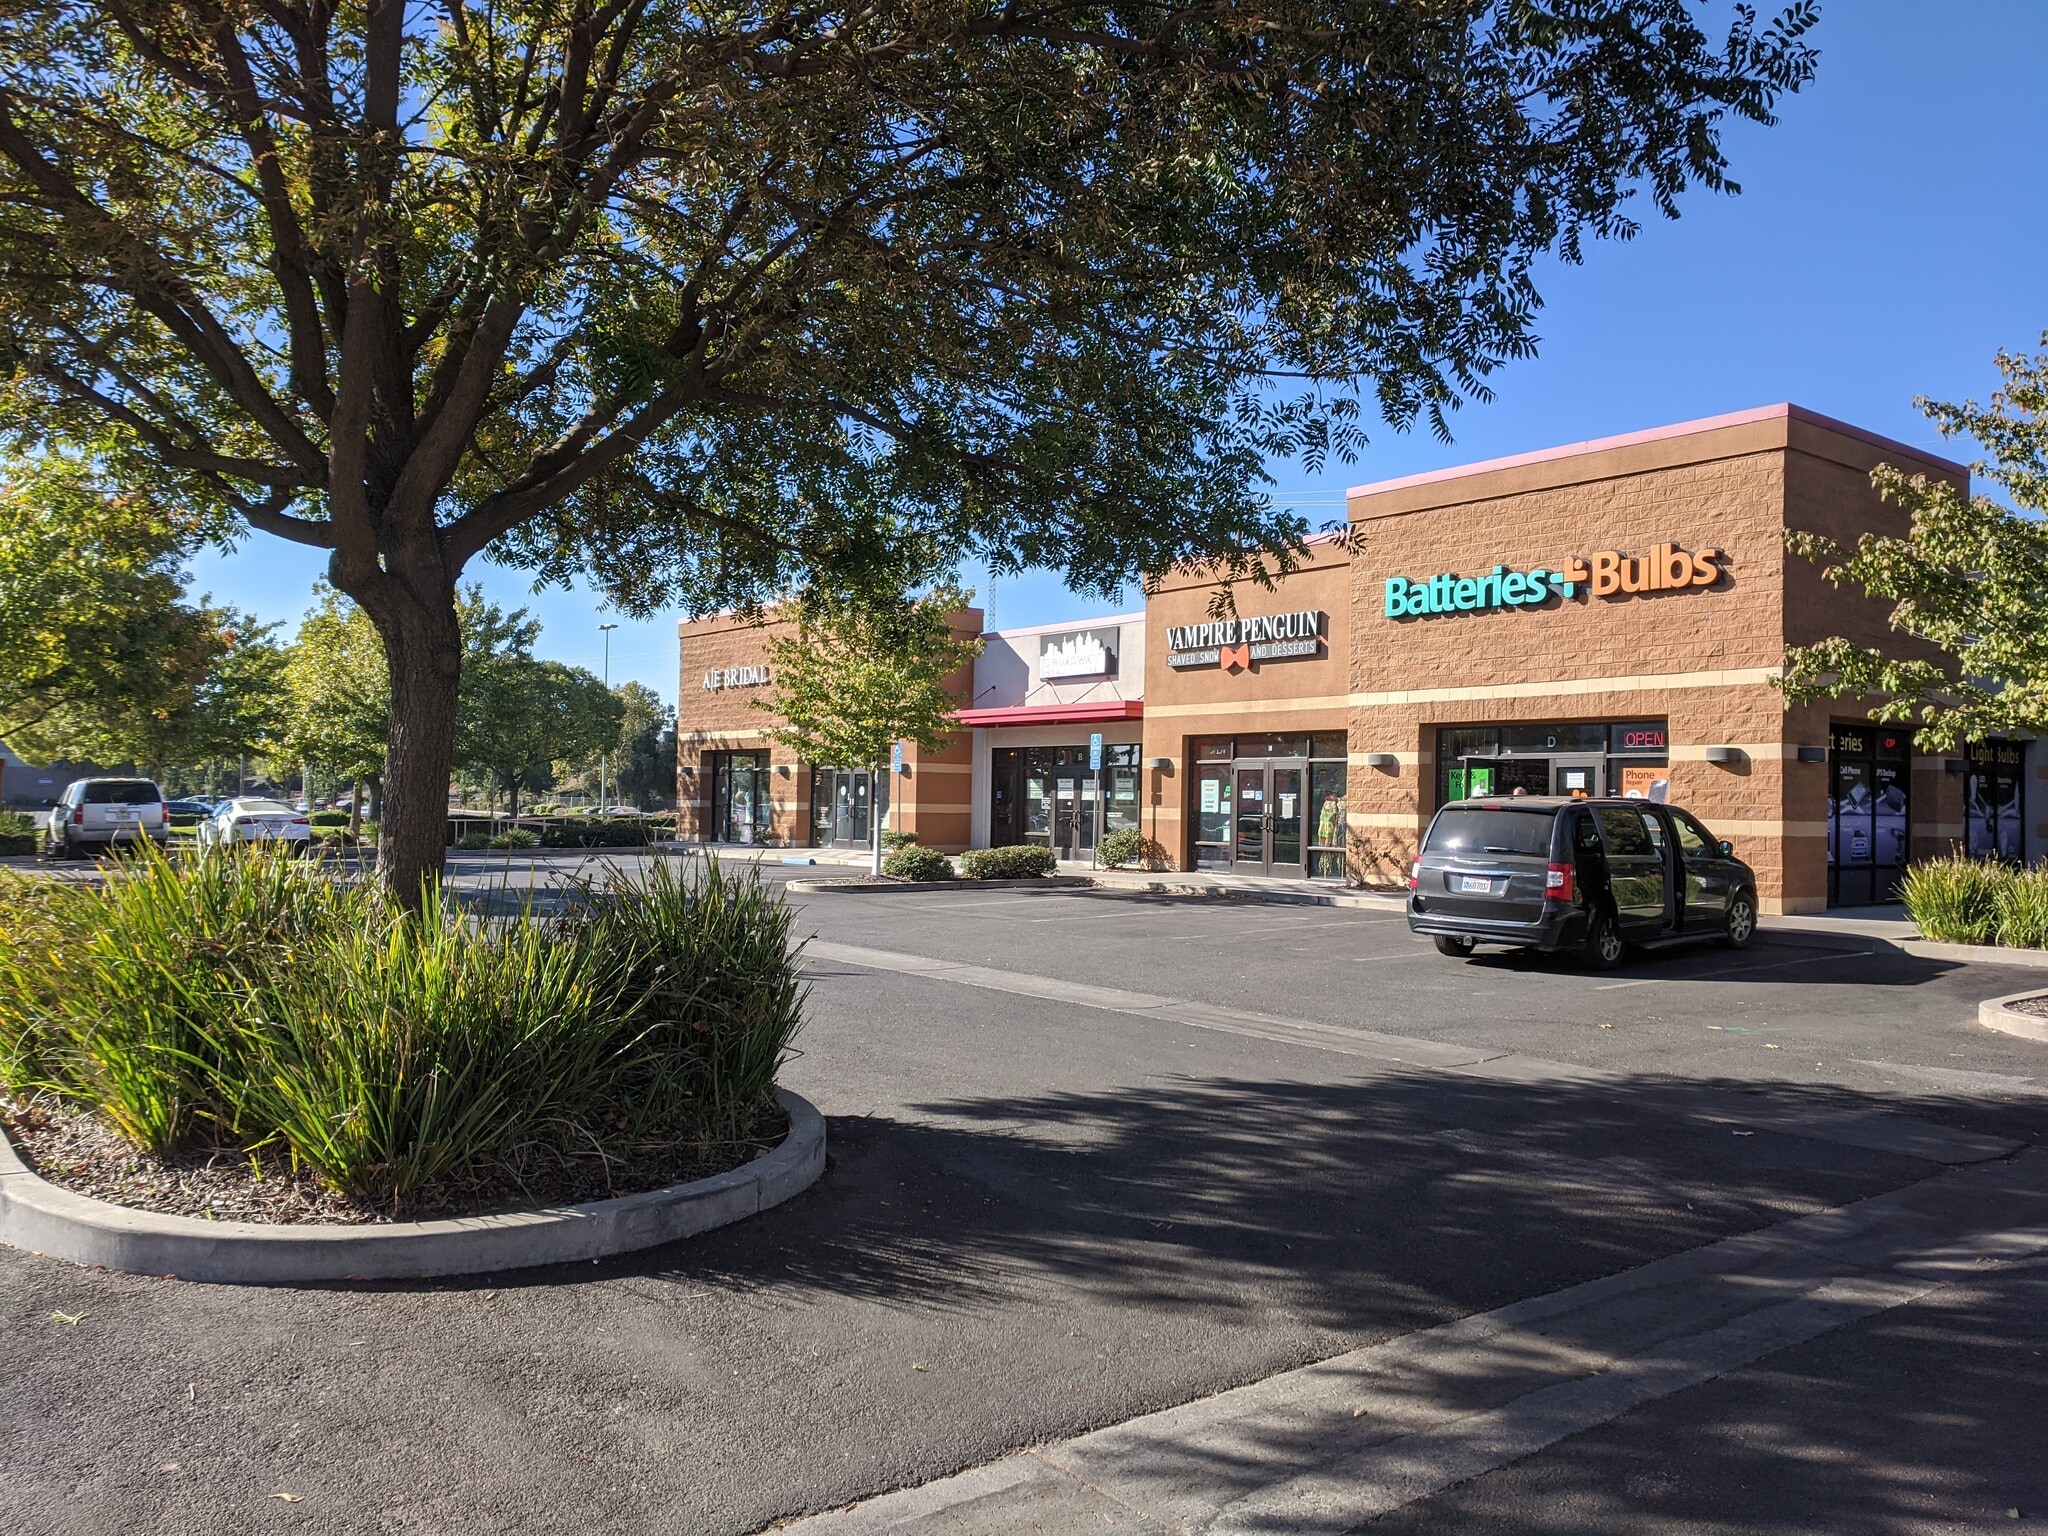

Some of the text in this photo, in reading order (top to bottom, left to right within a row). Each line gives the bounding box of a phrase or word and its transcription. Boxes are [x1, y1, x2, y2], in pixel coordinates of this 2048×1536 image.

[1385, 565, 1549, 618] Batteries
[1592, 542, 1721, 597] Bulbs
[1166, 610, 1321, 650] VAMPIRE PENGUIN
[1167, 641, 1316, 666] SHAVED SNOW AND DESSERTS
[723, 665, 767, 686] BRIDAL
[1547, 736, 1557, 748] D
[1625, 732, 1664, 746] OPEN
[1625, 770, 1655, 780] Phone
